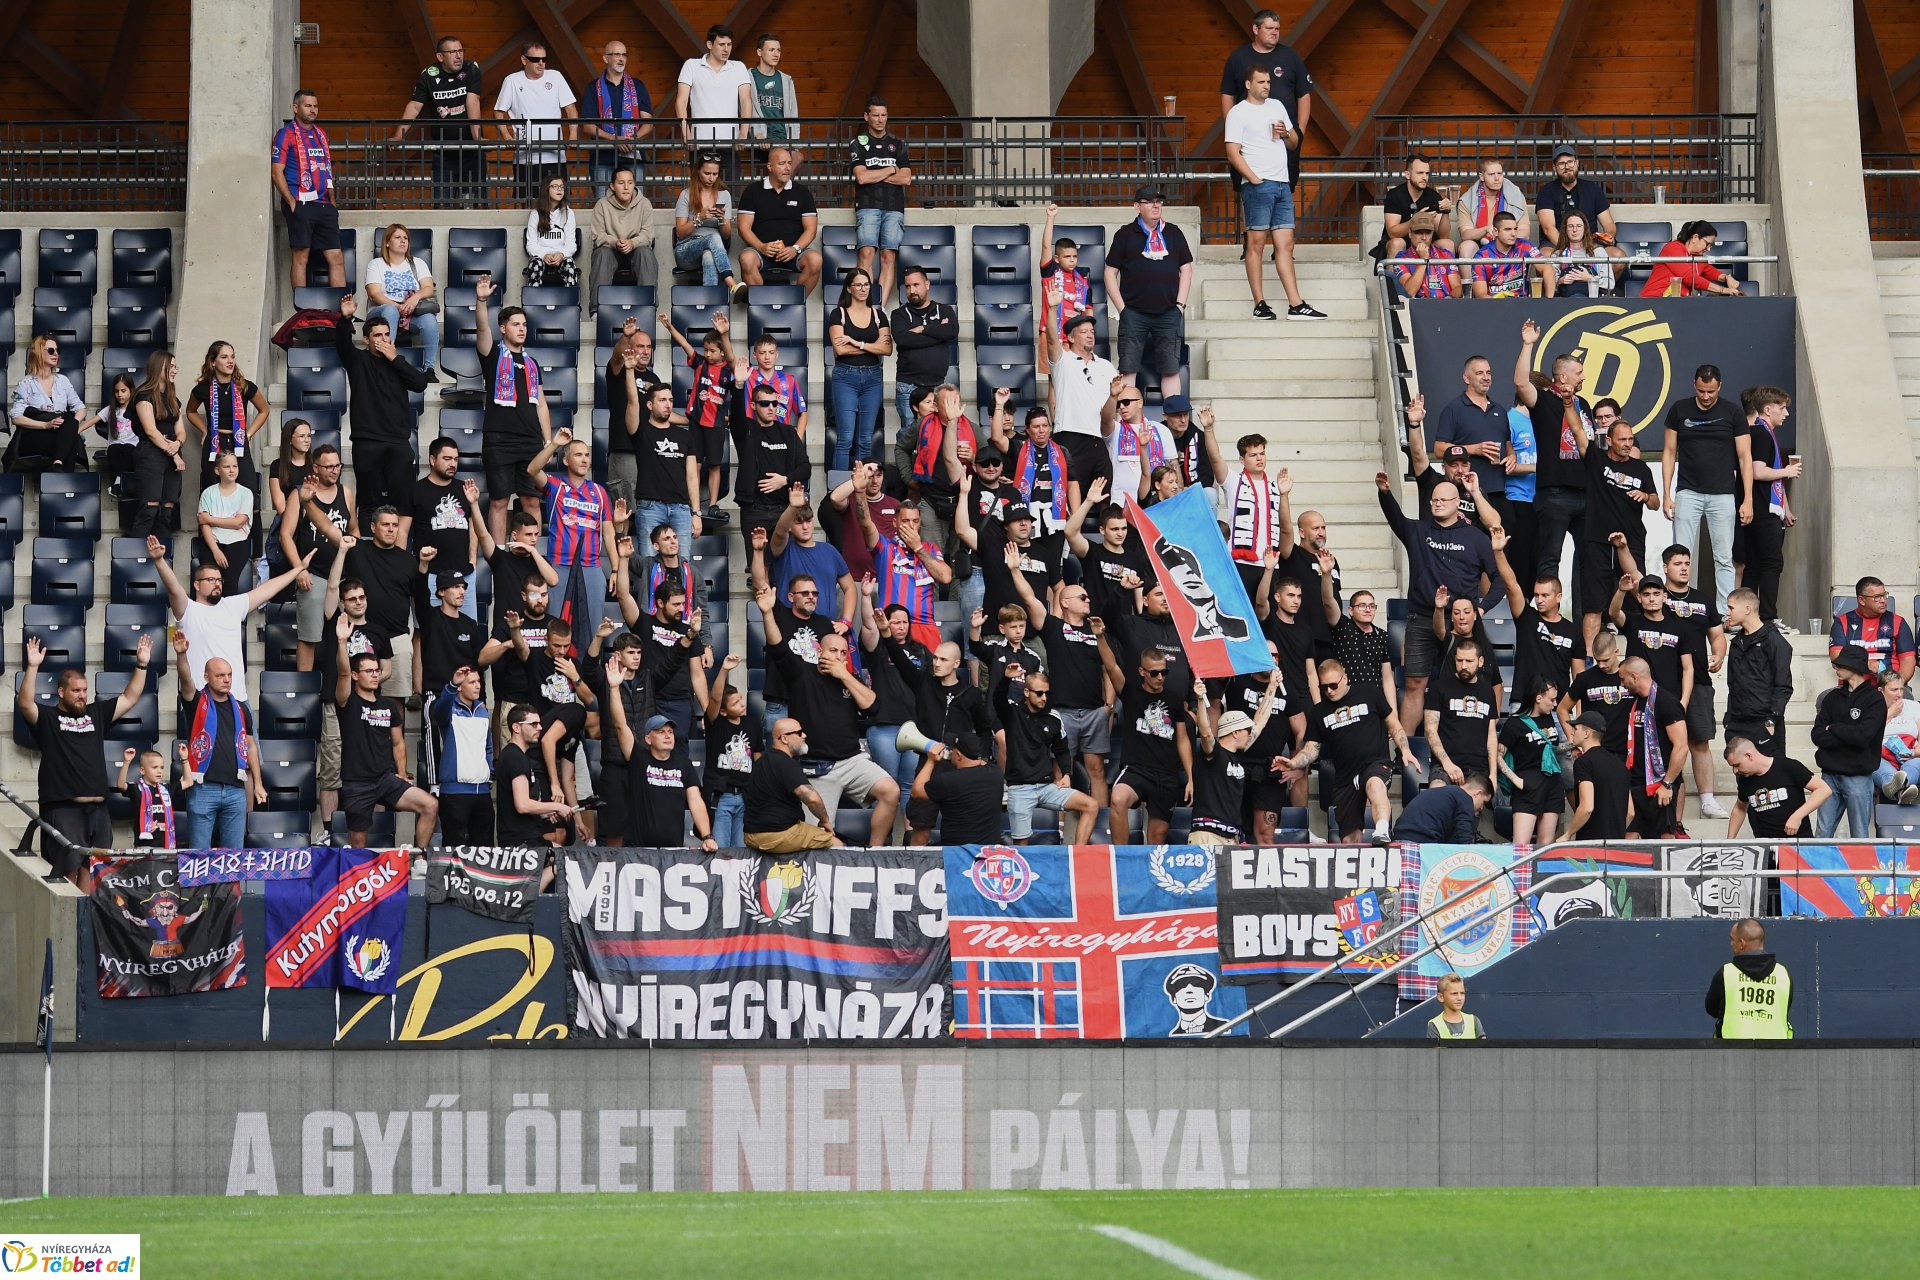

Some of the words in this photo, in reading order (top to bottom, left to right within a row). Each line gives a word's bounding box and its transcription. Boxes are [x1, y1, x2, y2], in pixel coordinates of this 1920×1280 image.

[433, 87, 467, 99] TIPPMIX
[540, 231, 562, 240] PUMA
[1426, 537, 1446, 550] Calvin
[1446, 543, 1465, 552] Klein
[1748, 787, 1788, 808] 928
[1166, 853, 1204, 869] 1928
[106, 875, 150, 889] RUM
[601, 870, 610, 925] 1995
[275, 860, 399, 978] Kutymorgók
[1339, 902, 1356, 924] NY
[1361, 897, 1375, 917] S
[962, 919, 1218, 955] Nyíregyháza
[1234, 914, 1340, 958] BOYS
[1351, 928, 1363, 949] F
[1739, 986, 1775, 1006] 1988
[226, 1112, 278, 1196] A
[302, 1093, 687, 1195] GYŰLÖLET
[712, 1064, 963, 1192] NEM
[990, 1092, 1251, 1189] PÁLYA!
